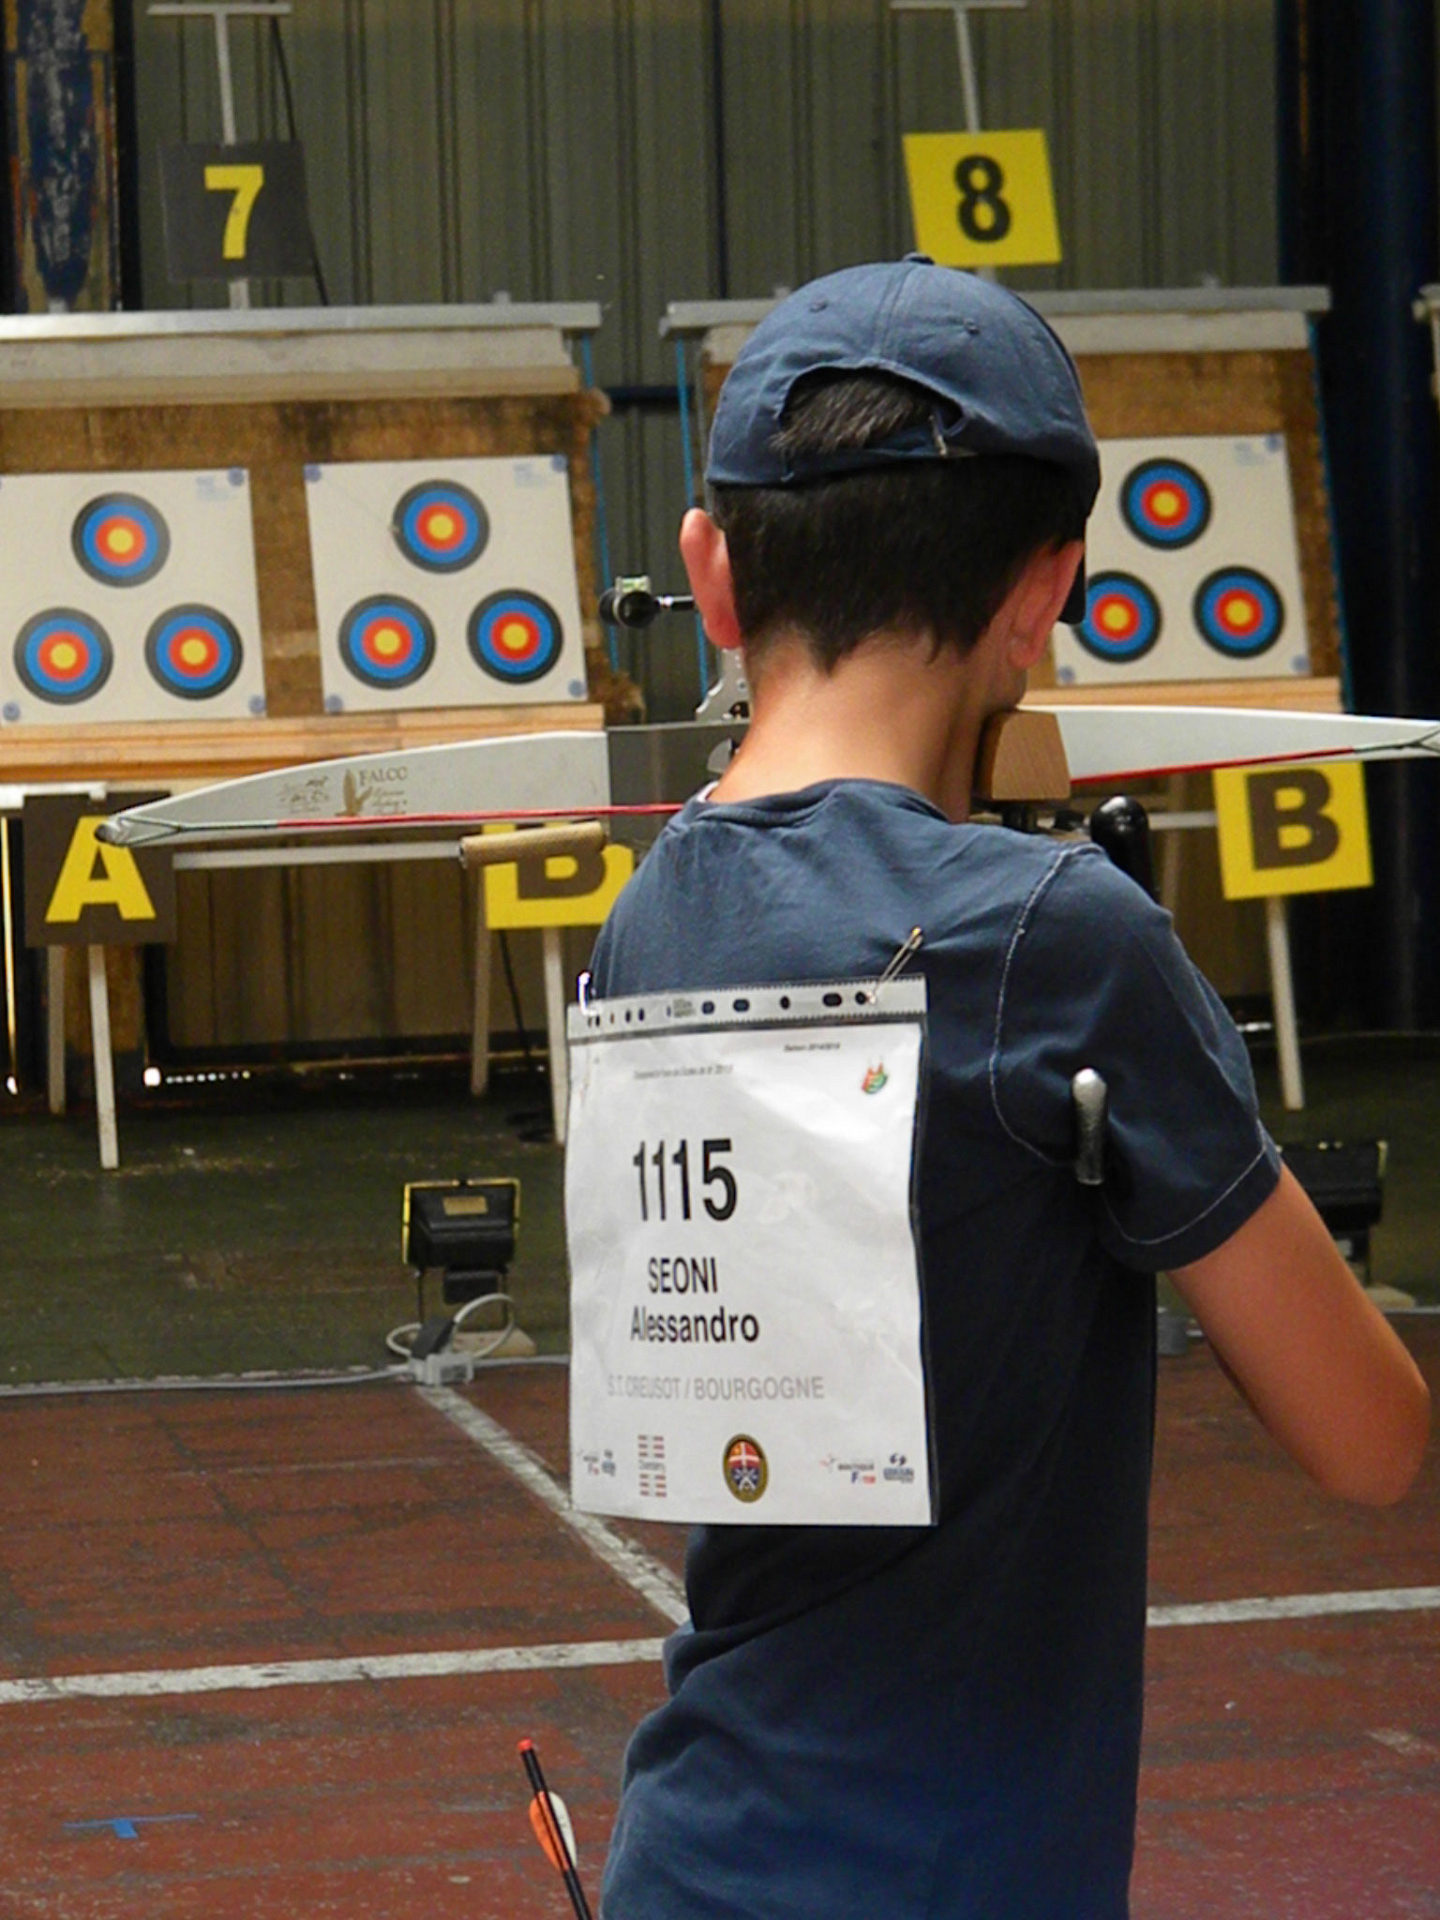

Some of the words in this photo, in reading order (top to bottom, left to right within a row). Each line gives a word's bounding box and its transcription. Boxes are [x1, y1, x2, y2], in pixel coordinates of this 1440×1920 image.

[204, 164, 265, 260] 7
[953, 155, 1011, 243] 8
[1247, 769, 1340, 871] B
[45, 815, 157, 923] A
[633, 1138, 737, 1222] 1115
[648, 1256, 718, 1294] SEONI
[630, 1305, 760, 1343] Alessandro
[694, 1376, 825, 1400] BOURGOGNE
